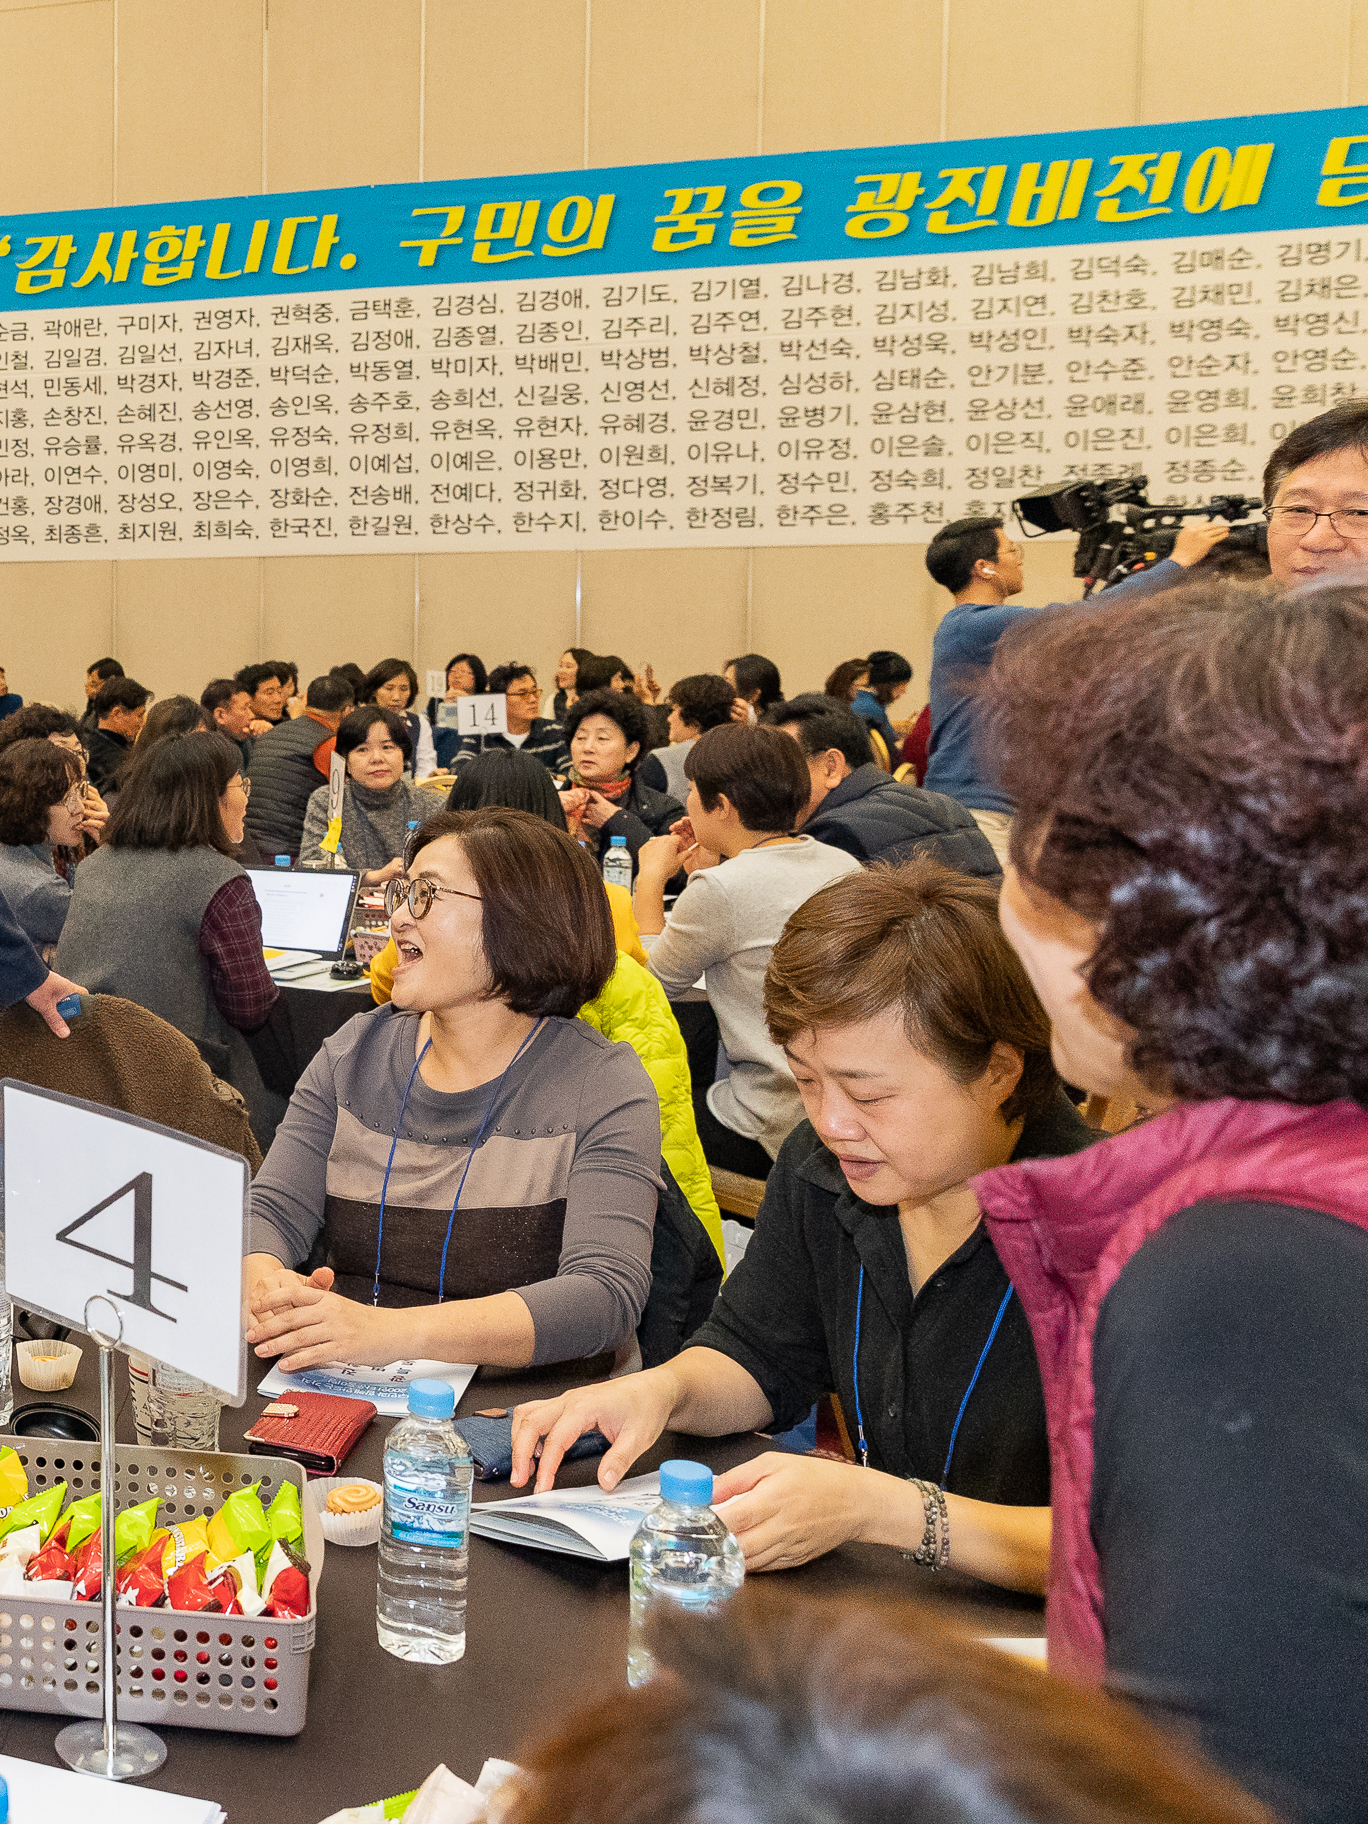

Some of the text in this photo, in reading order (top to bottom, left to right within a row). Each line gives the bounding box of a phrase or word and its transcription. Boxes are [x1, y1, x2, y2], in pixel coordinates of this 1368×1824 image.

[401, 195, 614, 267] 구민의
[652, 180, 803, 252] 꿈을
[845, 143, 1274, 239] 광진비전에
[44, 317, 107, 340] 곽애란,
[117, 312, 183, 336] 구미자,
[193, 307, 260, 331] 권영자,
[271, 302, 340, 326] 권혁중,
[349, 296, 420, 322] 금택훈,
[433, 292, 503, 317] 김경심,
[517, 287, 590, 313] 김경애,
[603, 283, 677, 308] 김기도,
[691, 277, 768, 303] 김기열,
[118, 342, 182, 365] 김일선,
[194, 337, 259, 361] 김자녀,
[271, 332, 338, 357] 김재옥,
[351, 328, 420, 352] 김정애,
[44, 375, 107, 398] 민동세,
[117, 371, 182, 394] 박경자,
[193, 367, 259, 391] 박경준,
[270, 362, 338, 386] 박덕순,
[350, 358, 420, 383] 박동열,
[431, 354, 503, 379] 박미자,
[43, 405, 107, 427] 손창진,
[117, 401, 182, 425] 손혜진,
[192, 397, 259, 422] 송선영,
[269, 393, 338, 418] 송인옥,
[348, 389, 419, 415] 송주호,
[514, 382, 589, 407] 신길웅,
[601, 378, 676, 404] 신영선,
[688, 374, 767, 400] 신혜정,
[117, 431, 182, 454] 유옥경,
[192, 427, 259, 451] 유인옥,
[269, 425, 338, 448] 유정숙,
[349, 421, 419, 445] 유정희,
[430, 417, 502, 442] 유현옥,
[513, 414, 588, 439] 유현자,
[599, 410, 676, 436] 유혜경,
[44, 464, 107, 486] 이연수,
[118, 461, 182, 484] 이영미,
[193, 458, 259, 481] 이영숙,
[270, 455, 338, 478] 이영희,
[349, 452, 419, 475] 이예섭,
[431, 449, 502, 473] 이예은,
[514, 447, 587, 471] 이용만,
[44, 494, 107, 516] 장경애,
[118, 491, 183, 514] 장성오,
[193, 489, 259, 512] 장은수,
[270, 486, 338, 510] 장화순,
[349, 483, 418, 507] 전송배,
[430, 481, 501, 504] 전예다,
[513, 479, 587, 503] 정귀화,
[599, 475, 674, 501] 정다영,
[118, 520, 182, 543] 최지원,
[193, 519, 259, 541] 최희숙,
[270, 516, 337, 539] 한국진,
[349, 514, 418, 537] 한길원,
[430, 512, 501, 536] 한상수,
[513, 510, 586, 534] 한수지,
[468, 703, 498, 728] 14
[55, 1170, 189, 1324] 4
